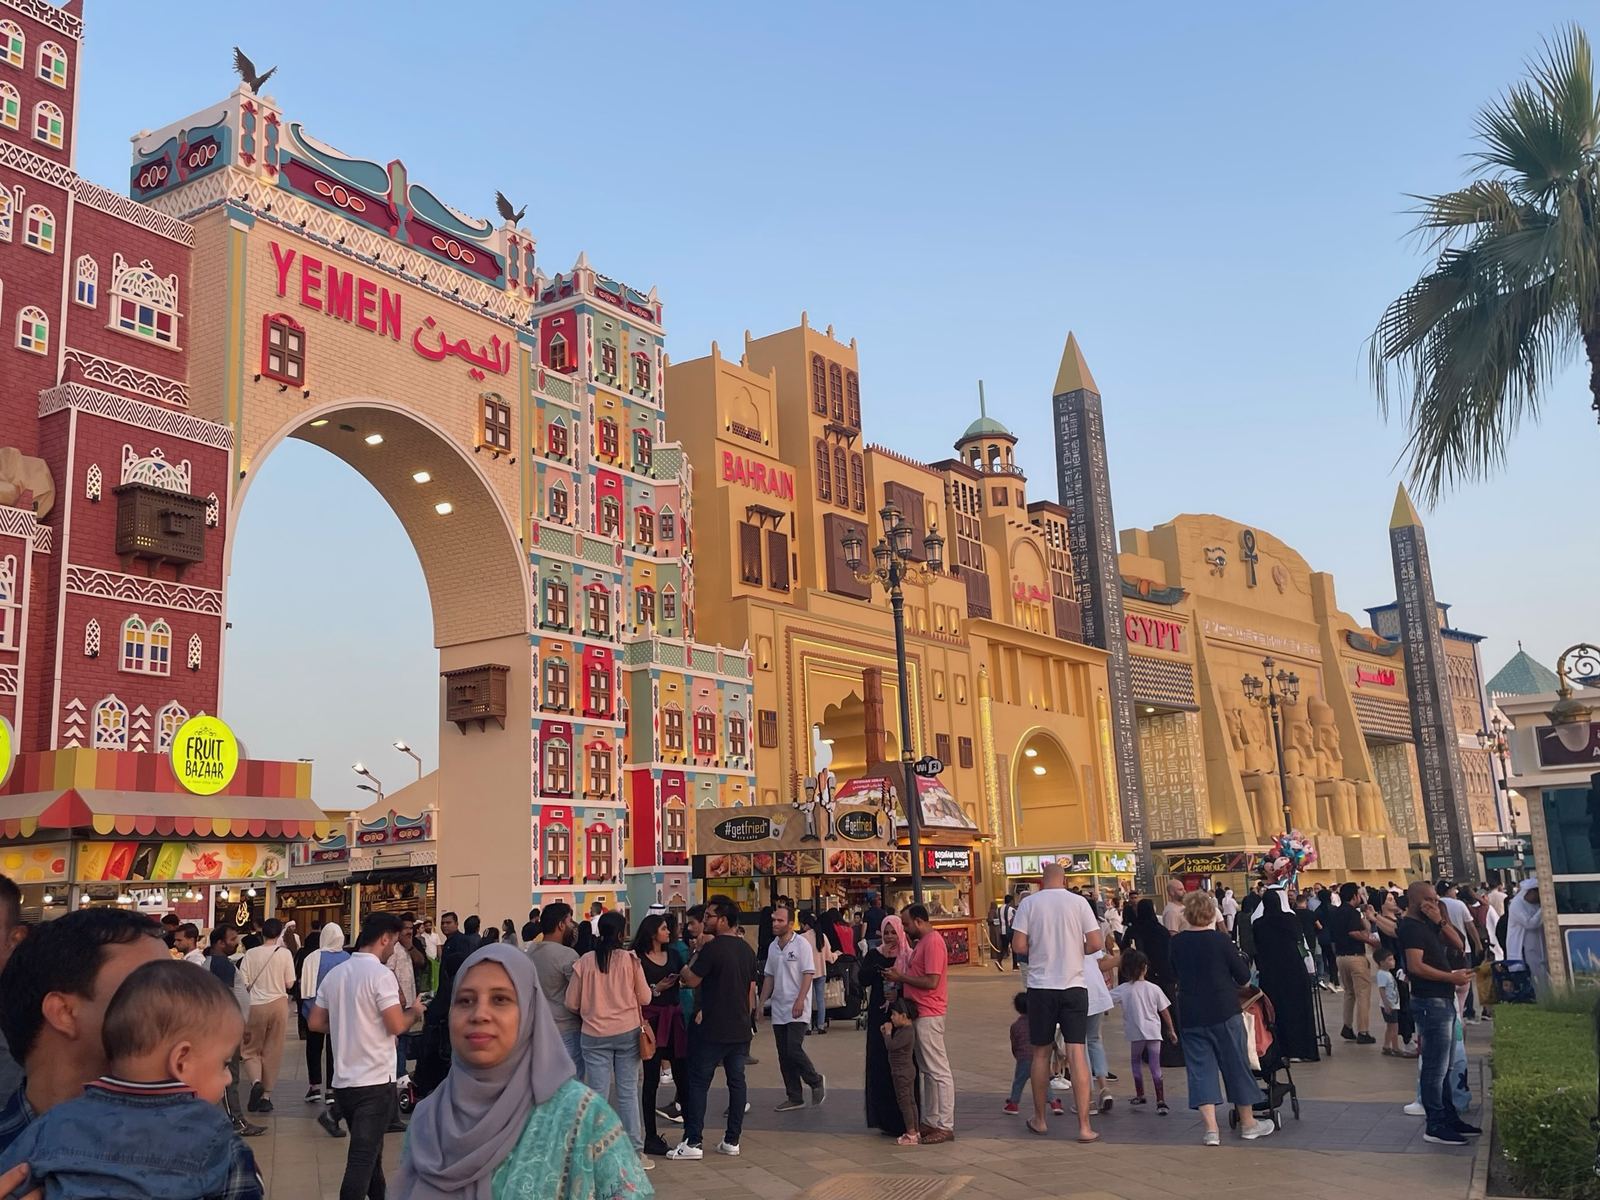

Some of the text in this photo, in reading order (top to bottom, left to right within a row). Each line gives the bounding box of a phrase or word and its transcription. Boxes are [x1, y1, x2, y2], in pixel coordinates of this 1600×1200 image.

[270, 241, 402, 341] YEMEN
[411, 316, 511, 381] اليمن
[723, 450, 794, 502] BAHRAIN
[1125, 614, 1183, 652] GYPT
[186, 736, 225, 761] FRUIT
[185, 760, 224, 779] BAZAAR
[725, 820, 765, 838] #getfried
[845, 815, 873, 835] #getfried
[1186, 863, 1227, 873] KARMOUZ
